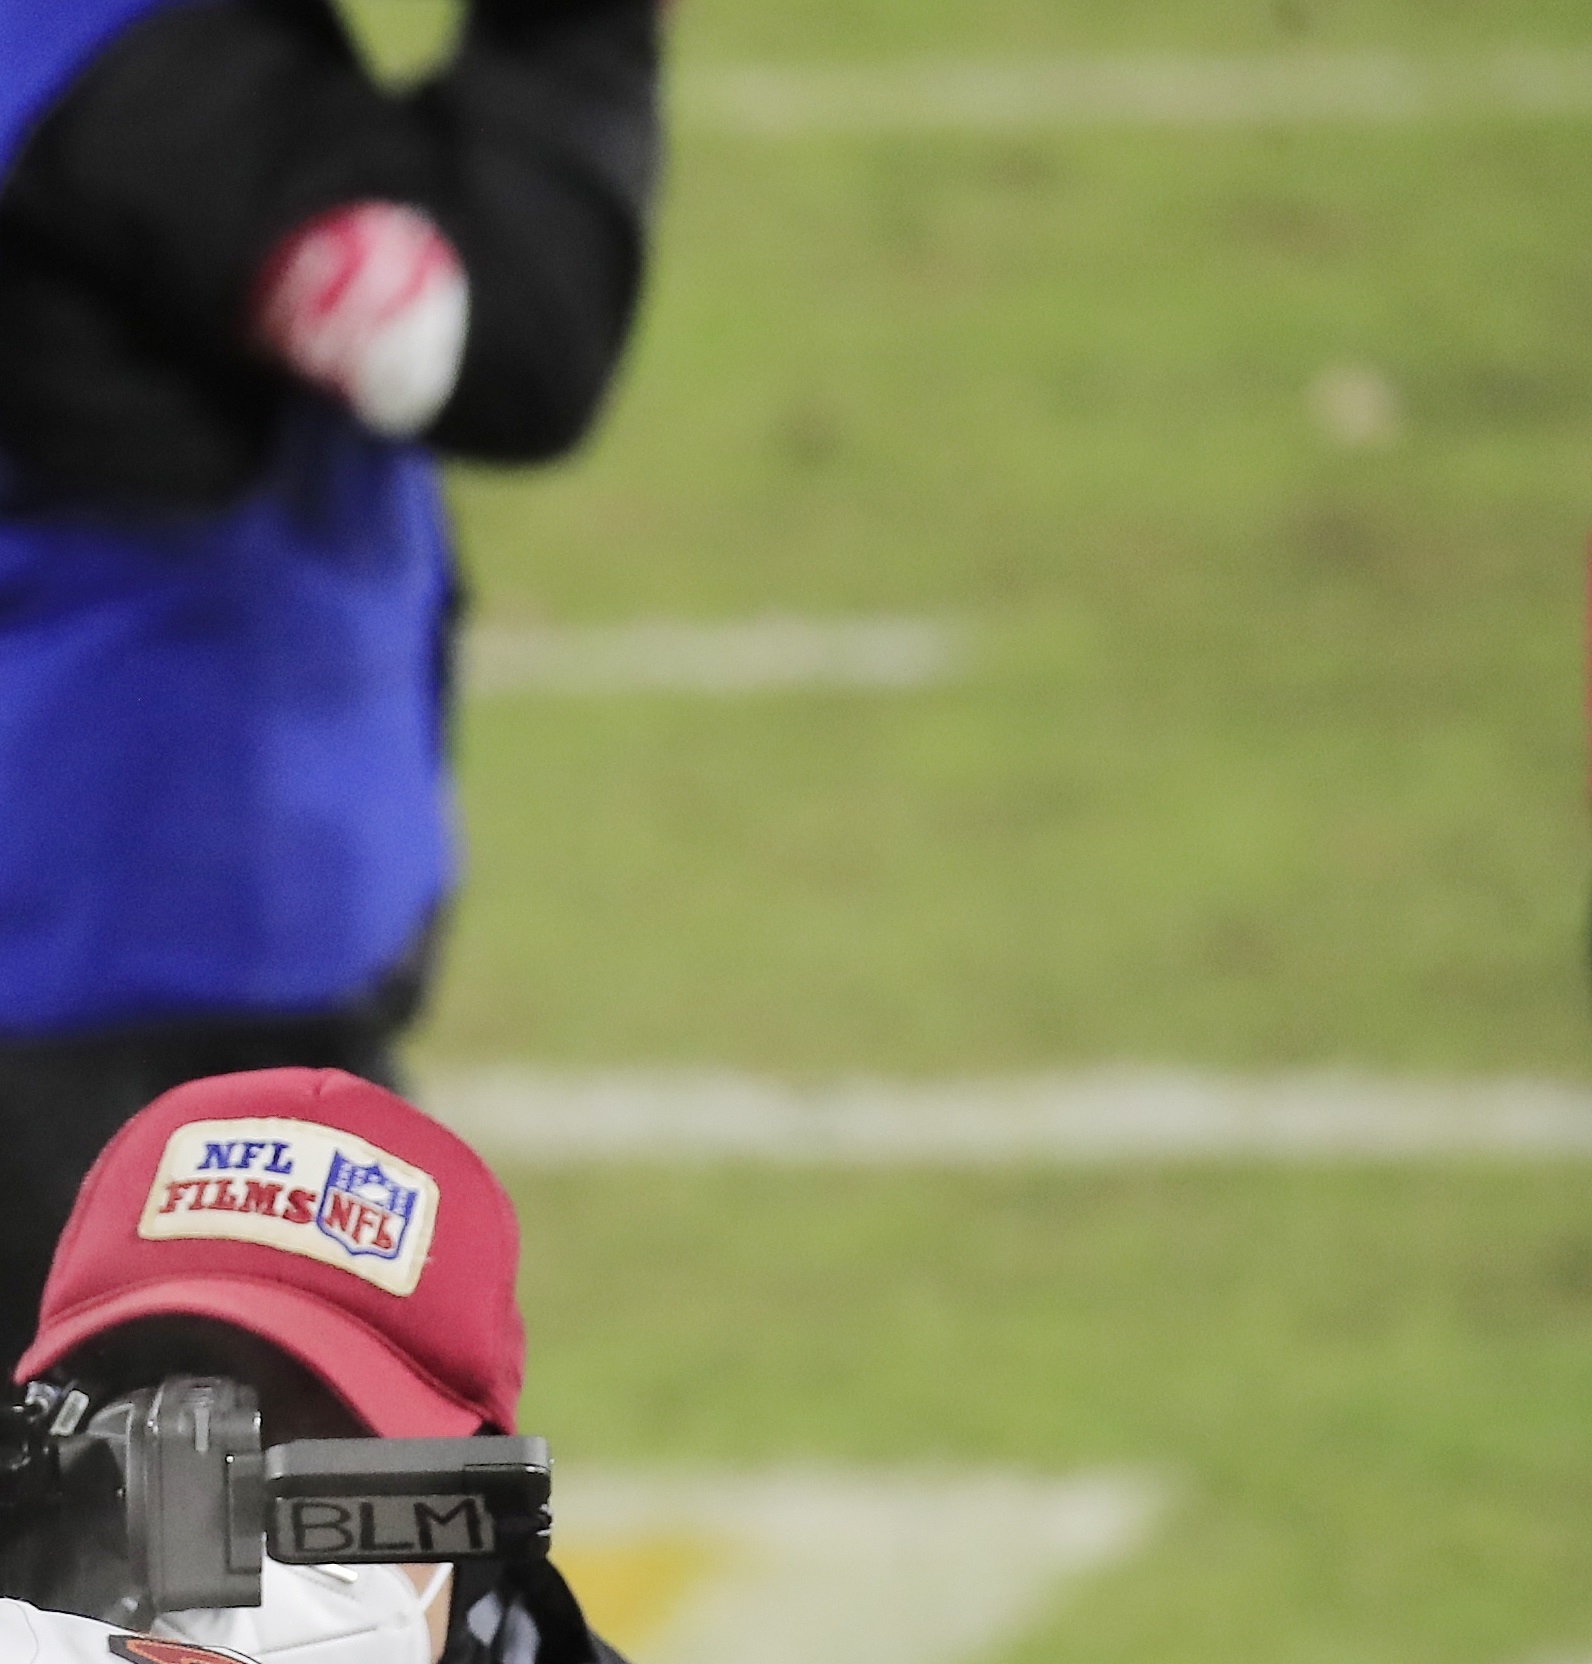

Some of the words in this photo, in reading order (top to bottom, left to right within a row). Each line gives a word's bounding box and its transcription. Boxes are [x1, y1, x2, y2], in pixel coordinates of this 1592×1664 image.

[197, 1141, 293, 1175] NFL
[158, 1178, 316, 1225] FILMS
[324, 1193, 395, 1250] NFL
[289, 1498, 485, 1552] BLM
